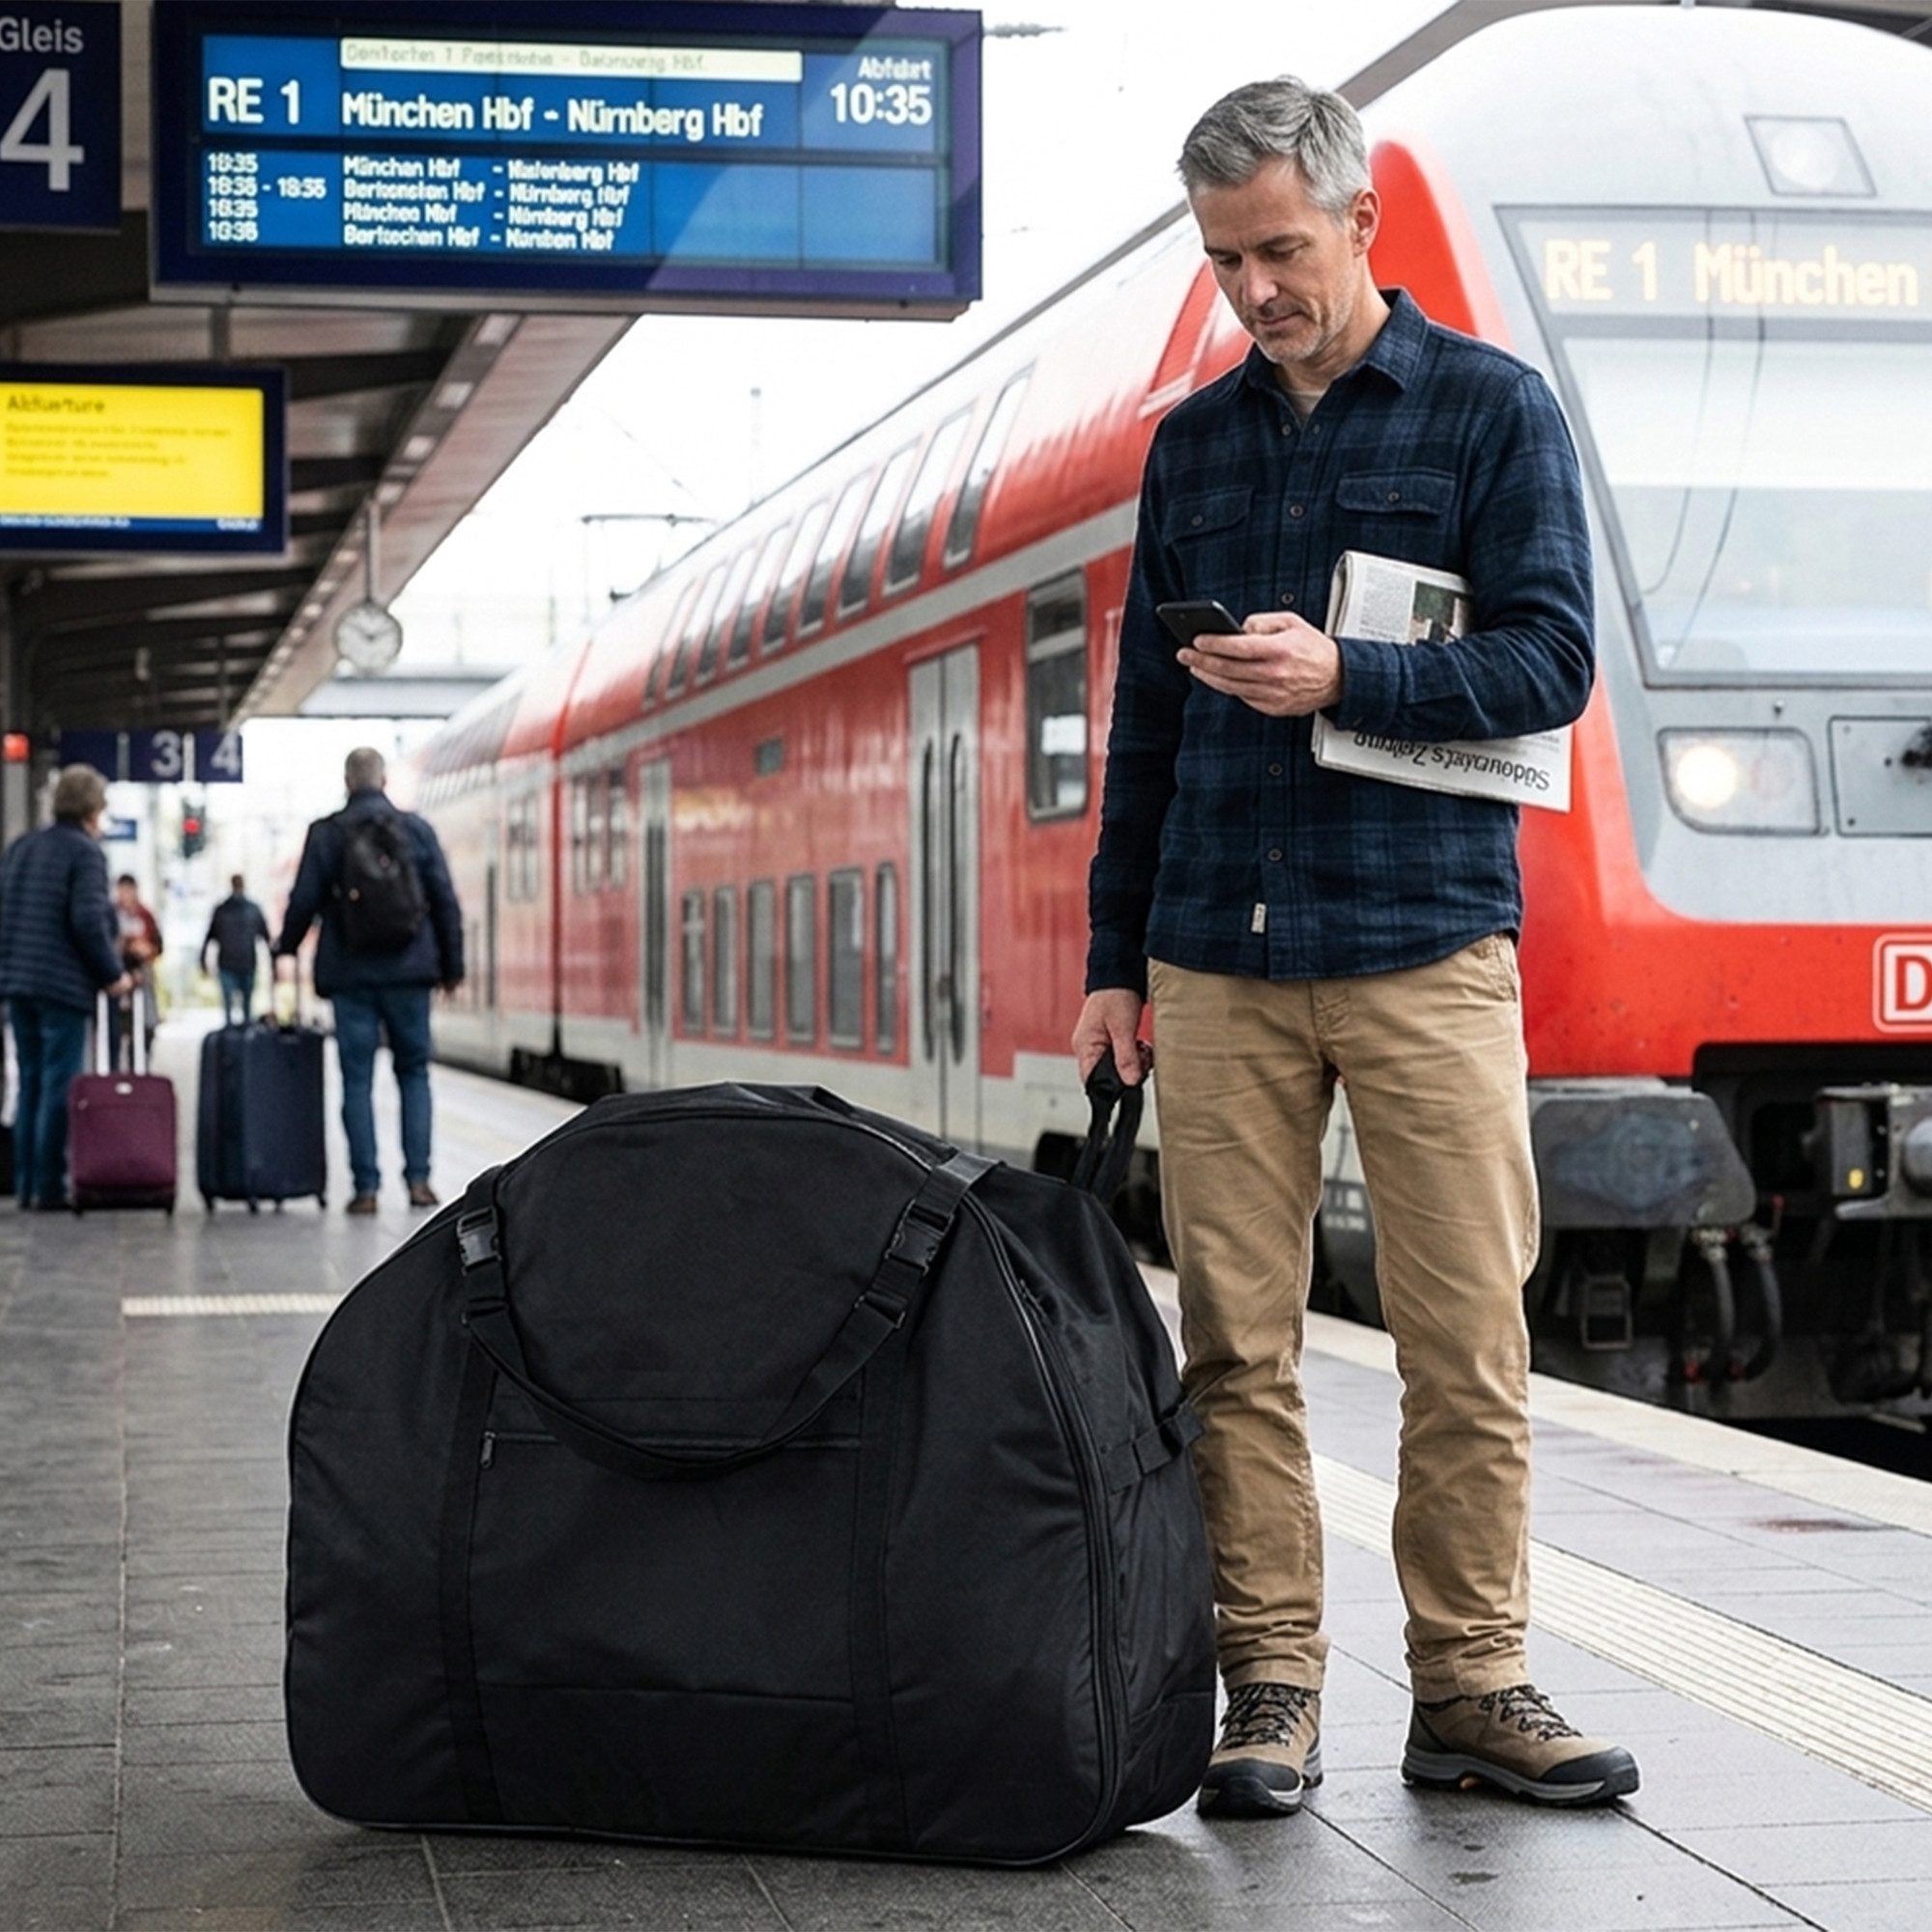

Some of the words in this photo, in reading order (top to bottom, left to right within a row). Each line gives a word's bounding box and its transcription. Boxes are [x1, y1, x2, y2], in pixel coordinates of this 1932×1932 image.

[0, 16, 84, 54] Gleis
[208, 76, 264, 124] RE
[279, 78, 300, 125] 1
[341, 92, 474, 129] München
[482, 96, 535, 131] Hbf
[566, 98, 704, 143] Nürnberg
[713, 102, 764, 138] Hbf
[829, 82, 932, 126] 10:35
[0, 68, 85, 191] 4
[1546, 238, 1613, 301] RE
[1631, 241, 1658, 302] 1
[1693, 241, 1919, 307] München
[151, 730, 182, 778] 3
[210, 731, 242, 776] 4
